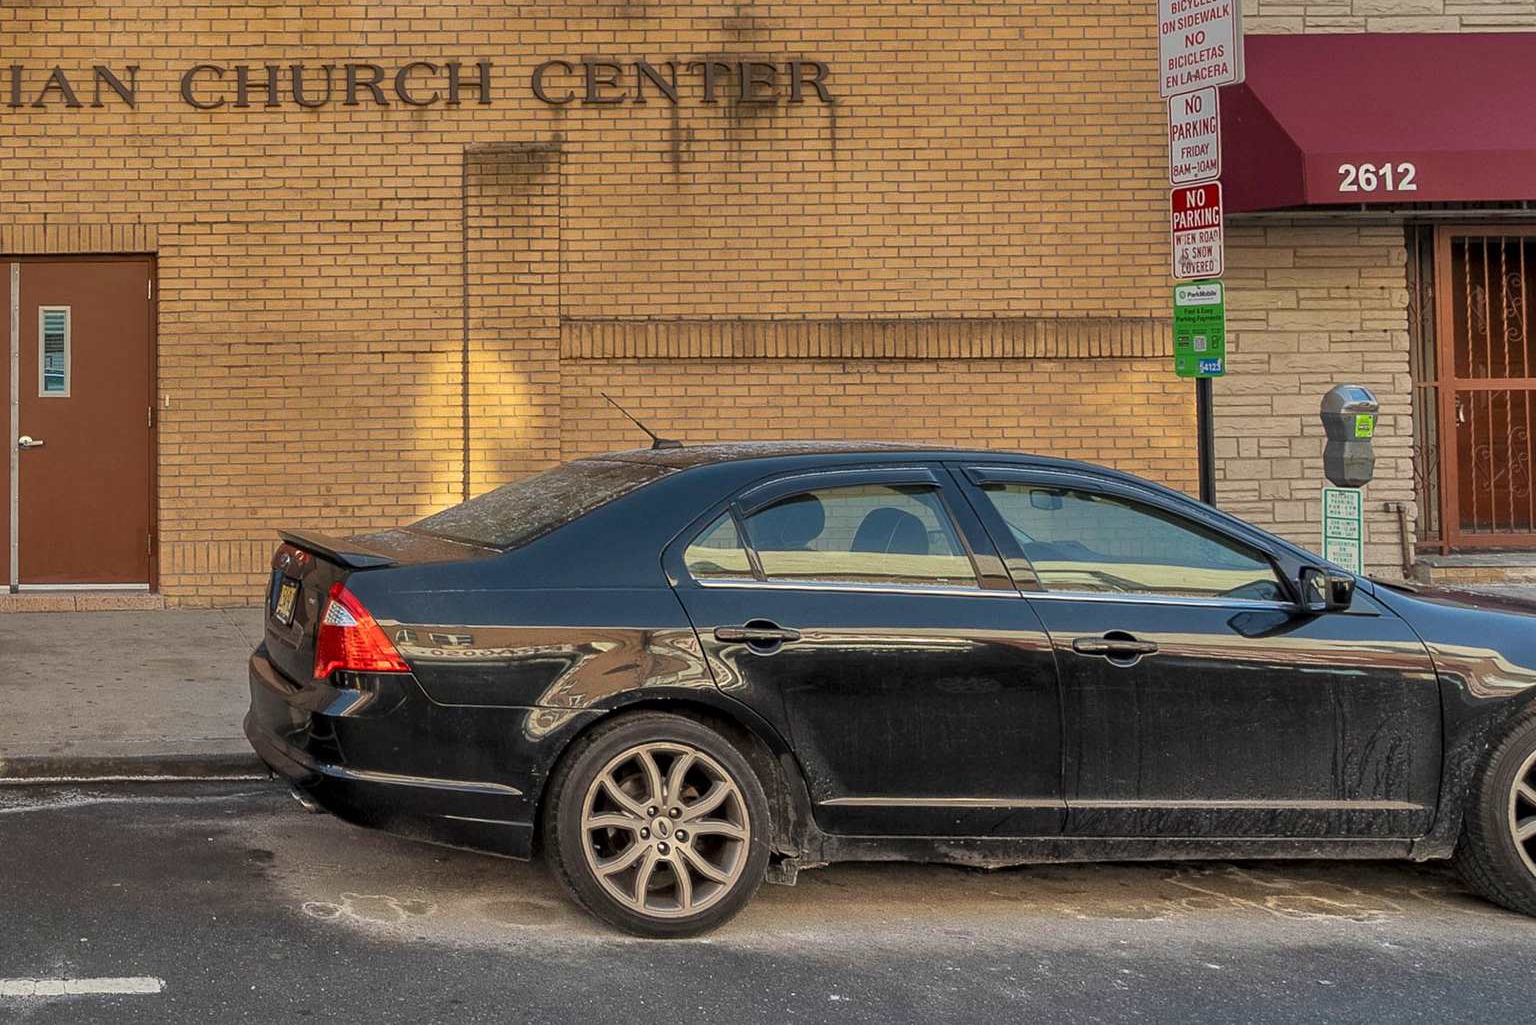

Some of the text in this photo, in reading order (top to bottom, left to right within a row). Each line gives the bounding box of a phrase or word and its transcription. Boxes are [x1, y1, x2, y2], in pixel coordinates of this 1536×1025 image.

[1162, 3, 1230, 35] ON SIDEWALK
[1184, 30, 1206, 48] NO
[1168, 44, 1225, 71] BICICLETAS
[180, 60, 494, 110] CHURCH
[530, 59, 836, 106] CENTER
[1166, 62, 1229, 89] EN LA ACERA
[1185, 95, 1202, 116] NO
[1172, 116, 1216, 142] PARKING
[1180, 142, 1210, 160] FRIDAY
[1338, 162, 1417, 192] 2612
[1186, 188, 1206, 207] NO
[1173, 206, 1220, 230] PARKING
[1181, 245, 1213, 260] IS SNOW
[1181, 260, 1214, 274] COVERED
